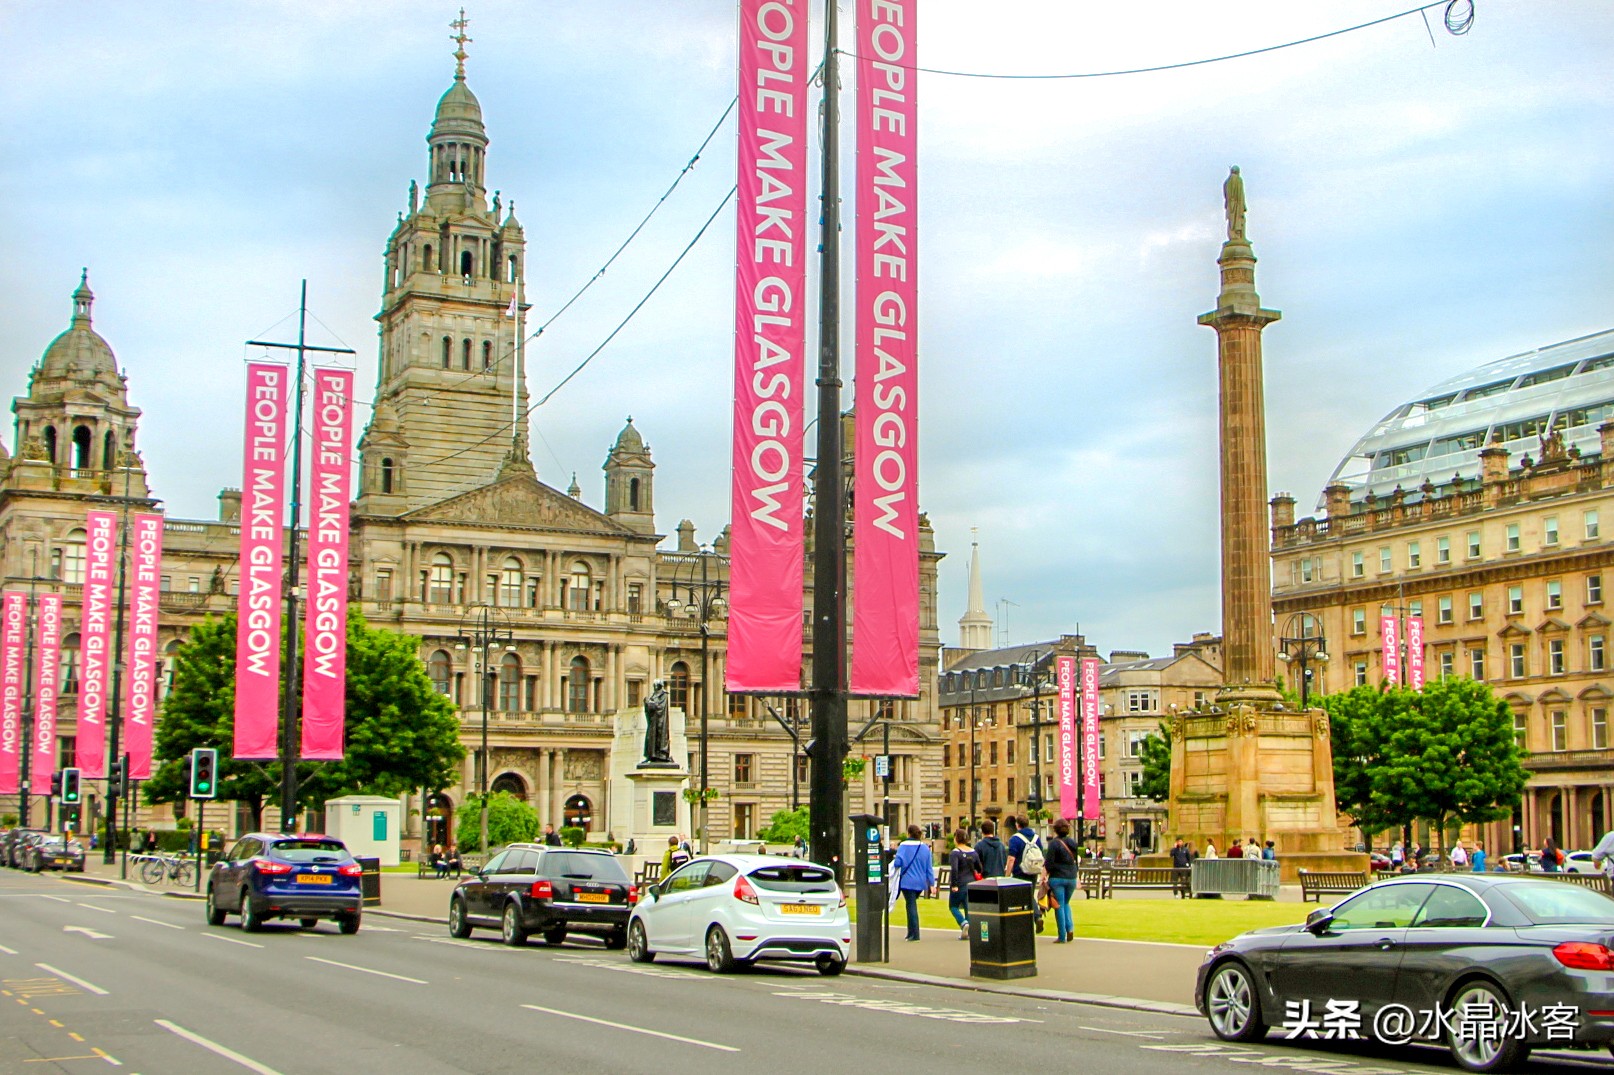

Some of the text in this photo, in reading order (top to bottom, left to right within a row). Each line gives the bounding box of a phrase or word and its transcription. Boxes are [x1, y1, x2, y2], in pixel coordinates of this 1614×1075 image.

[751, 0, 794, 531] OPLE MAKE GLASGOW
[872, 0, 906, 540] EOPLE MAKE GLASGOW
[247, 370, 278, 677] PEOPLE MAKE GLASGOW
[314, 375, 345, 678] PEOPLE MAKE GLASGOW
[2, 596, 21, 753] PEOPLE MAKE GLASGOW
[38, 598, 57, 754] PEOPLE MAKE GLASGOW
[84, 517, 110, 724] PEOPLE MAKE GLASGOW
[132, 519, 157, 725] PEOPLE MAKE GLASGOW
[1385, 620, 1395, 666] PEOPLE
[1411, 622, 1422, 693] PEOPLE MA
[1061, 660, 1072, 786] PEOPLE MAKE GLASGOW
[1086, 662, 1095, 787] PEOPLE MAKE GLASGOW
[871, 828, 877, 840] P
